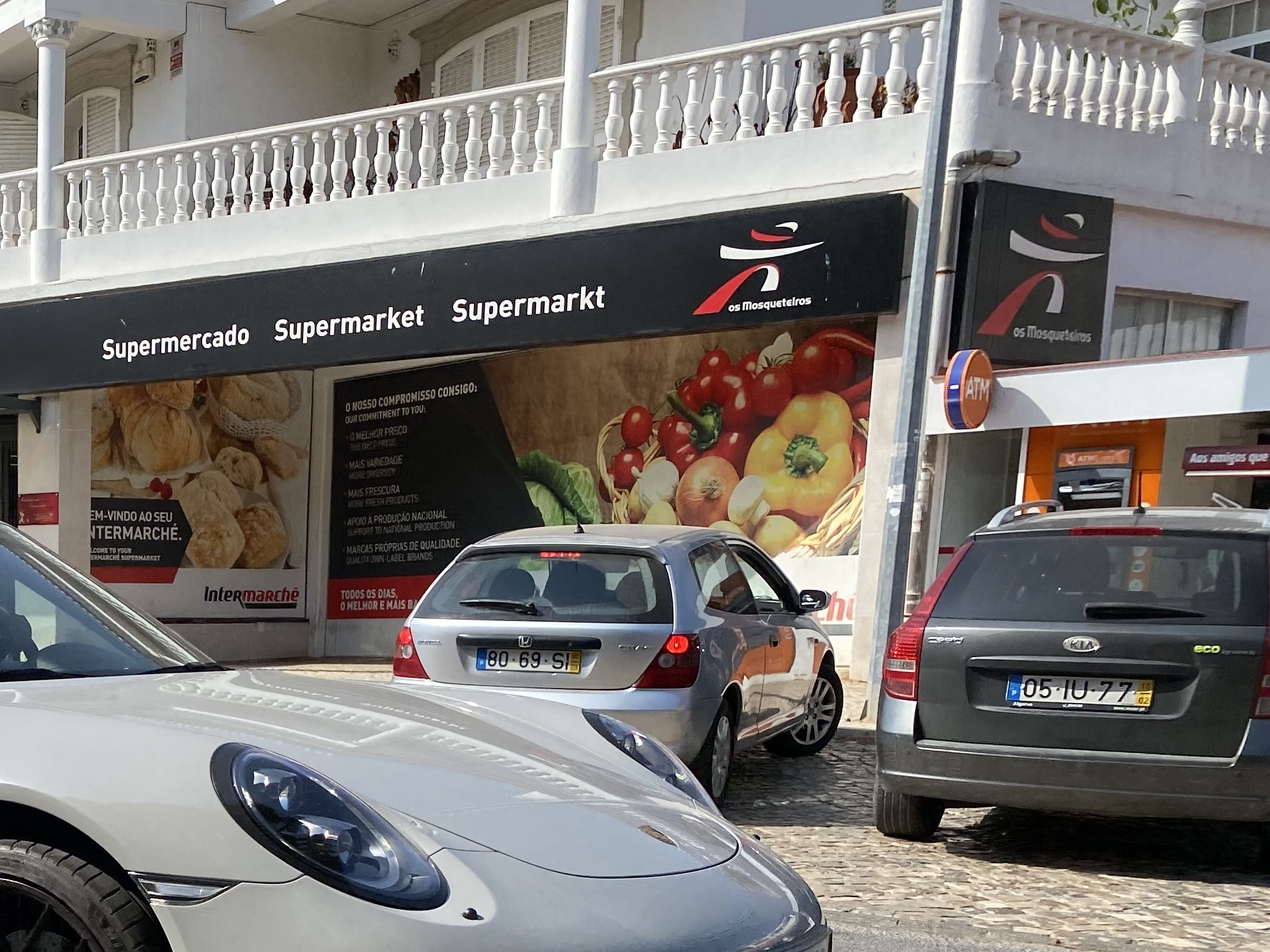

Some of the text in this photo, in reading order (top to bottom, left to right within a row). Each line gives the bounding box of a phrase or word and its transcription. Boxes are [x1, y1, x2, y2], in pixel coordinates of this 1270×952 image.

[728, 296, 812, 312] os Mosqueteiros
[102, 286, 606, 362] Supermercado Supermarket Supermarkt
[1013, 325, 1092, 344] os Mosqueteiros
[964, 377, 991, 402] ATM
[345, 382, 478, 412] O NOSSO COMPROMISSO CONSIGO:
[345, 414, 358, 424] OUR
[358, 408, 400, 422] COMMITMENT
[402, 406, 410, 416] TO
[350, 432, 354, 441] O
[356, 428, 384, 440] MELHOR
[349, 460, 365, 469] MAIS
[1210, 452, 1246, 466] amigos
[1248, 453, 1268, 464] que
[348, 485, 400, 498] MAIS FRESCURA
[90, 510, 173, 523] EM-VINDO AO SEU
[412, 510, 448, 521] NACIONAL
[90, 523, 182, 541] NTERMARCHÉ.
[414, 520, 455, 532] PRODUCTION
[346, 544, 373, 554] MARCAS
[409, 541, 418, 550] DE
[341, 588, 398, 600] TODOS OS DIAS,
[340, 602, 345, 611] O
[347, 601, 378, 610] MELHOR
[380, 600, 384, 610] E
[386, 600, 406, 610] MAIS
[1070, 638, 1096, 650] KIA
[1193, 645, 1221, 654] eco
[1138, 697, 1149, 705] 02
